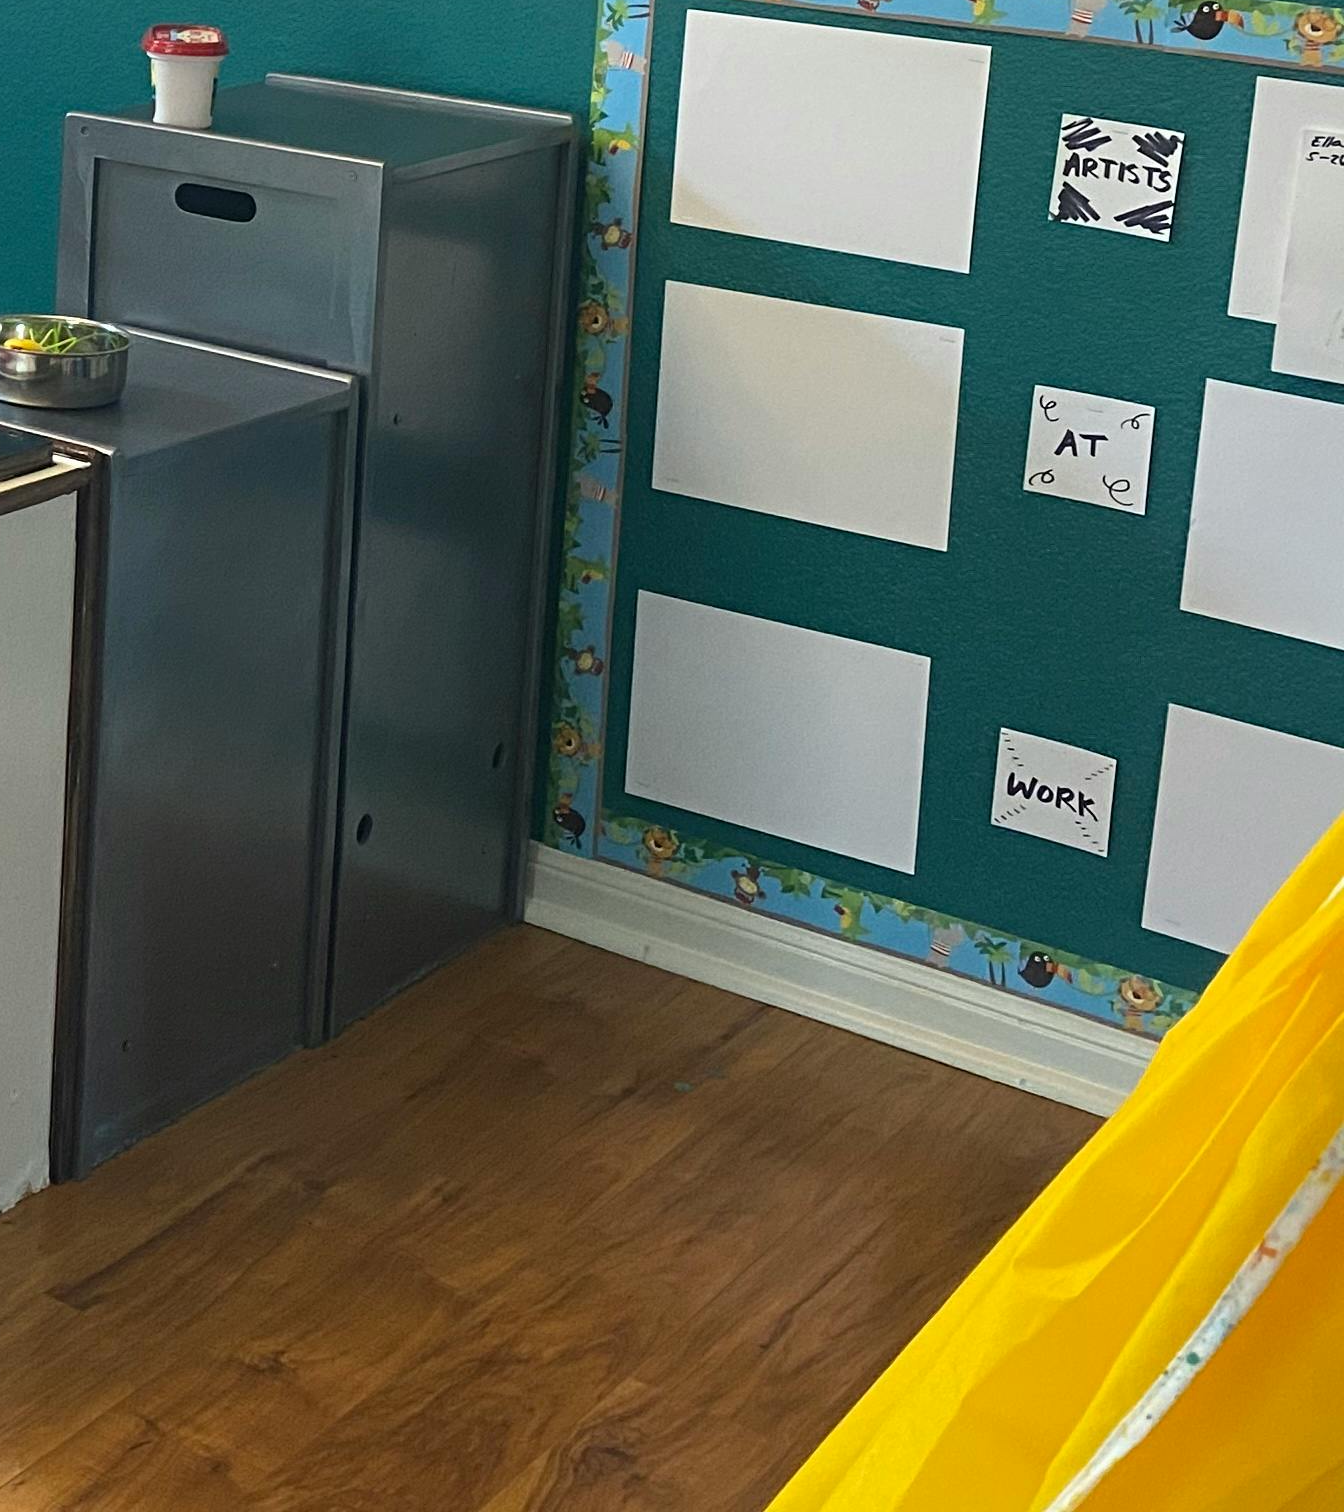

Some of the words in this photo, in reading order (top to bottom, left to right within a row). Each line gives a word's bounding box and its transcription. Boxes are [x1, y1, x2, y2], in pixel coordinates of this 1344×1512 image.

[1063, 153, 1173, 193] ARTISTS
[1054, 429, 1109, 457] AT
[1006, 772, 1099, 822] WORK
